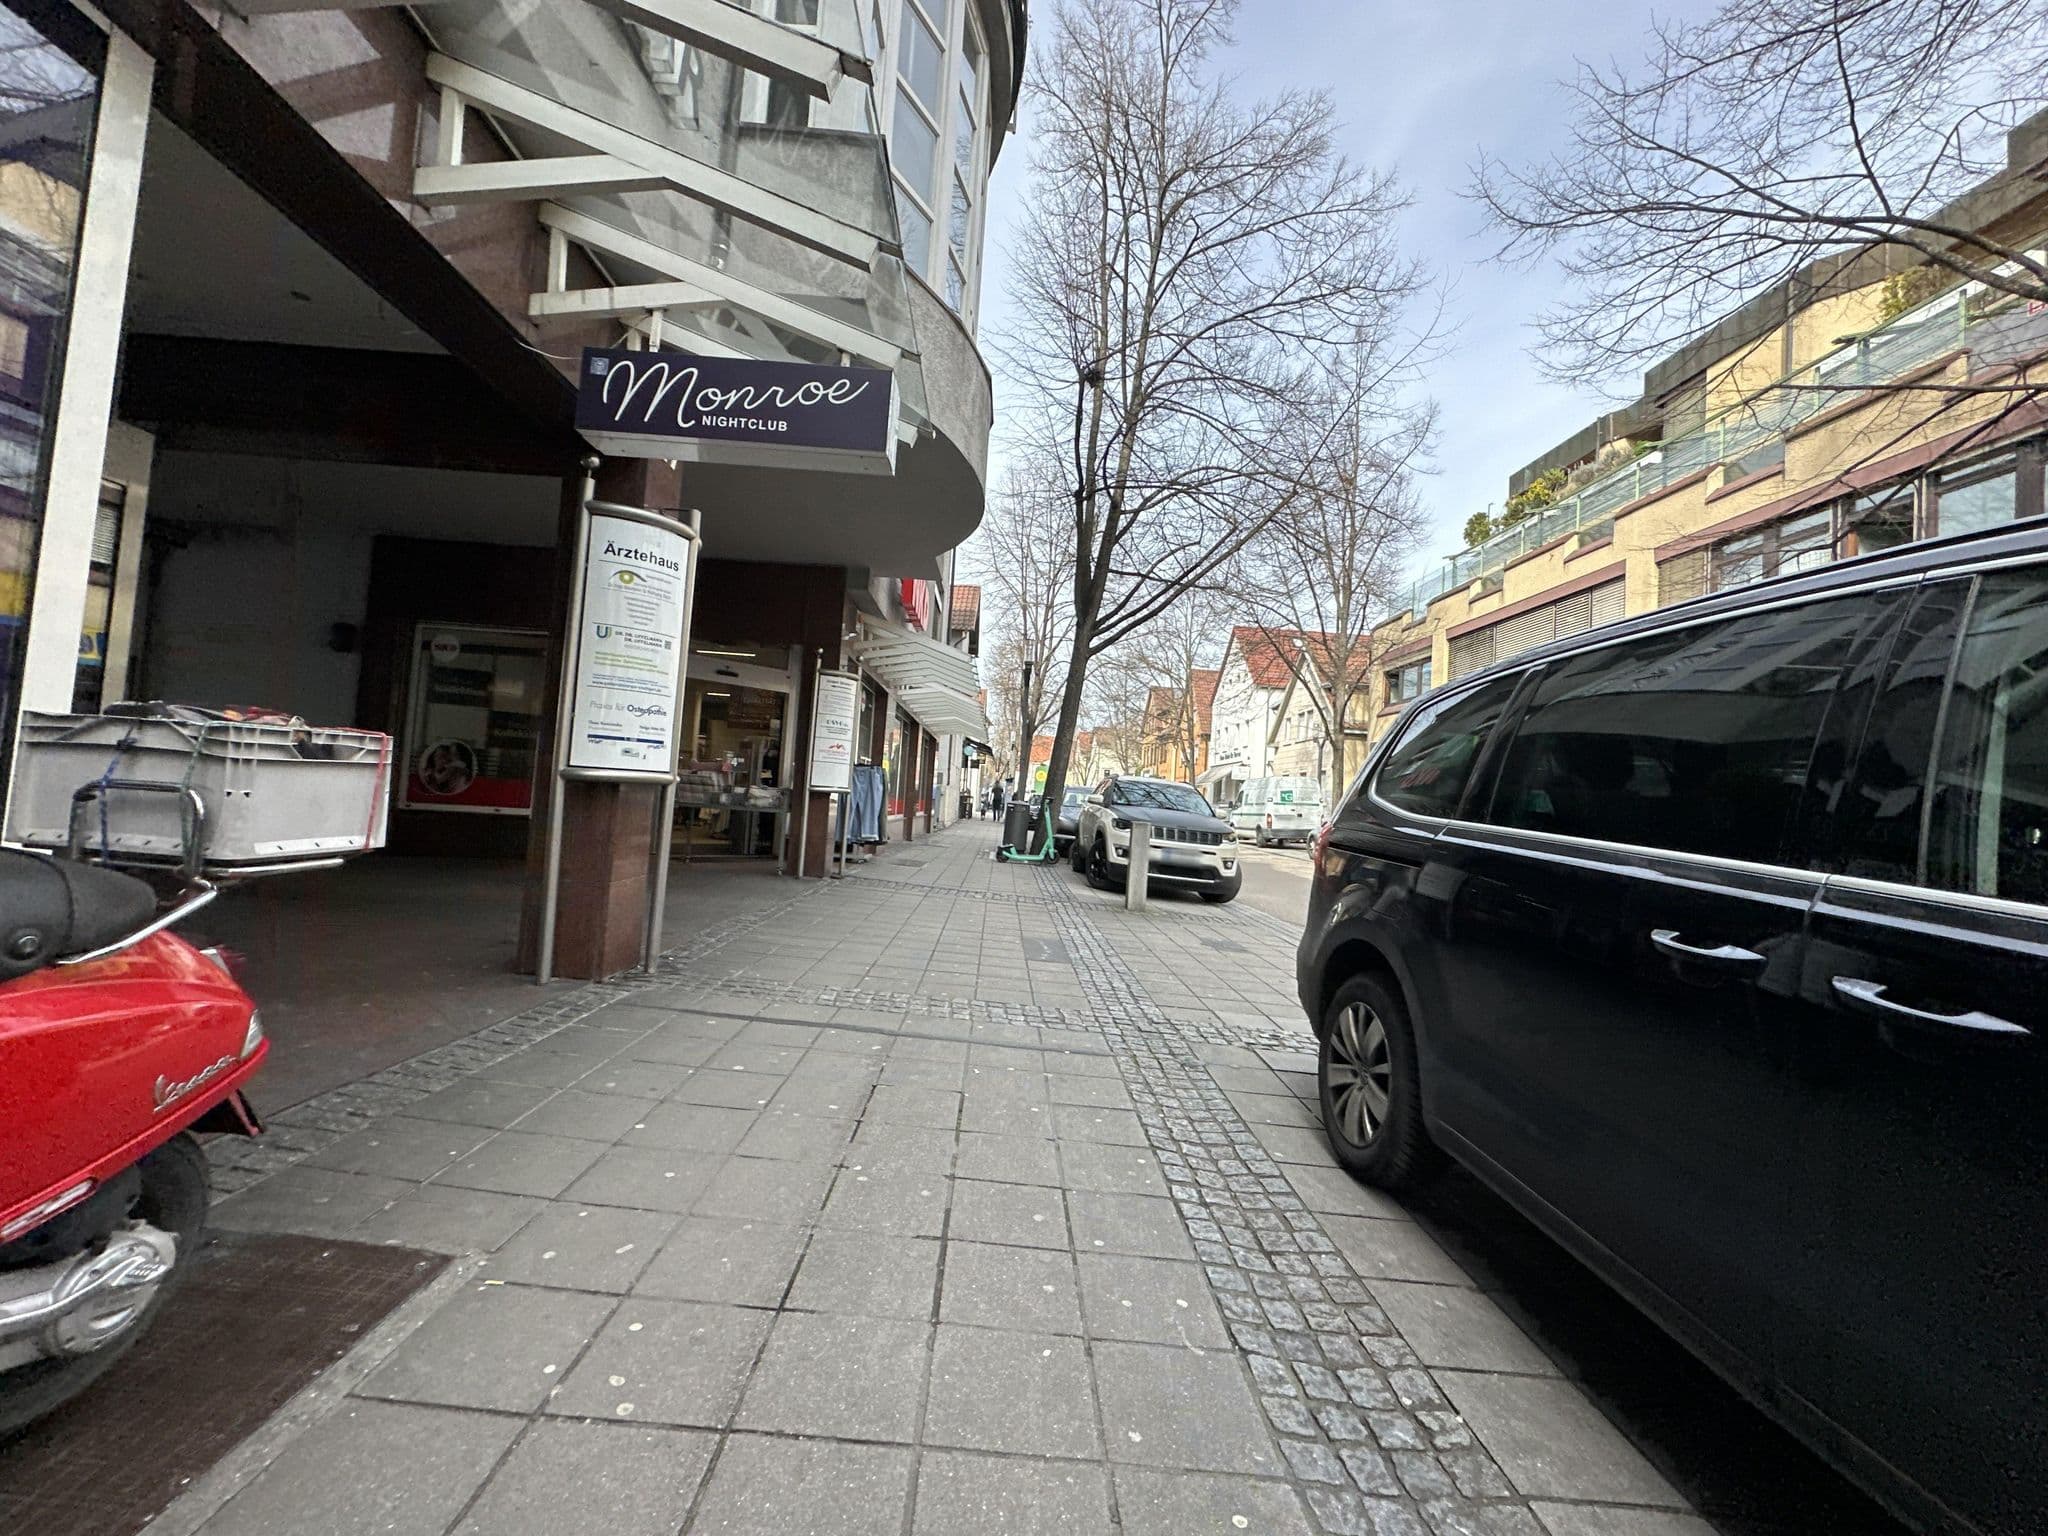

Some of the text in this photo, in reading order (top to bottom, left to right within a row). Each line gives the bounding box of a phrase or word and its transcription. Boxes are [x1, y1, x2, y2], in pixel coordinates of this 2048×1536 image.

[602, 360, 870, 428] Monroe
[701, 415, 788, 432] NIGHTCLUB
[603, 540, 680, 572] Ärztehaus
[626, 704, 667, 717] Osteopathie
